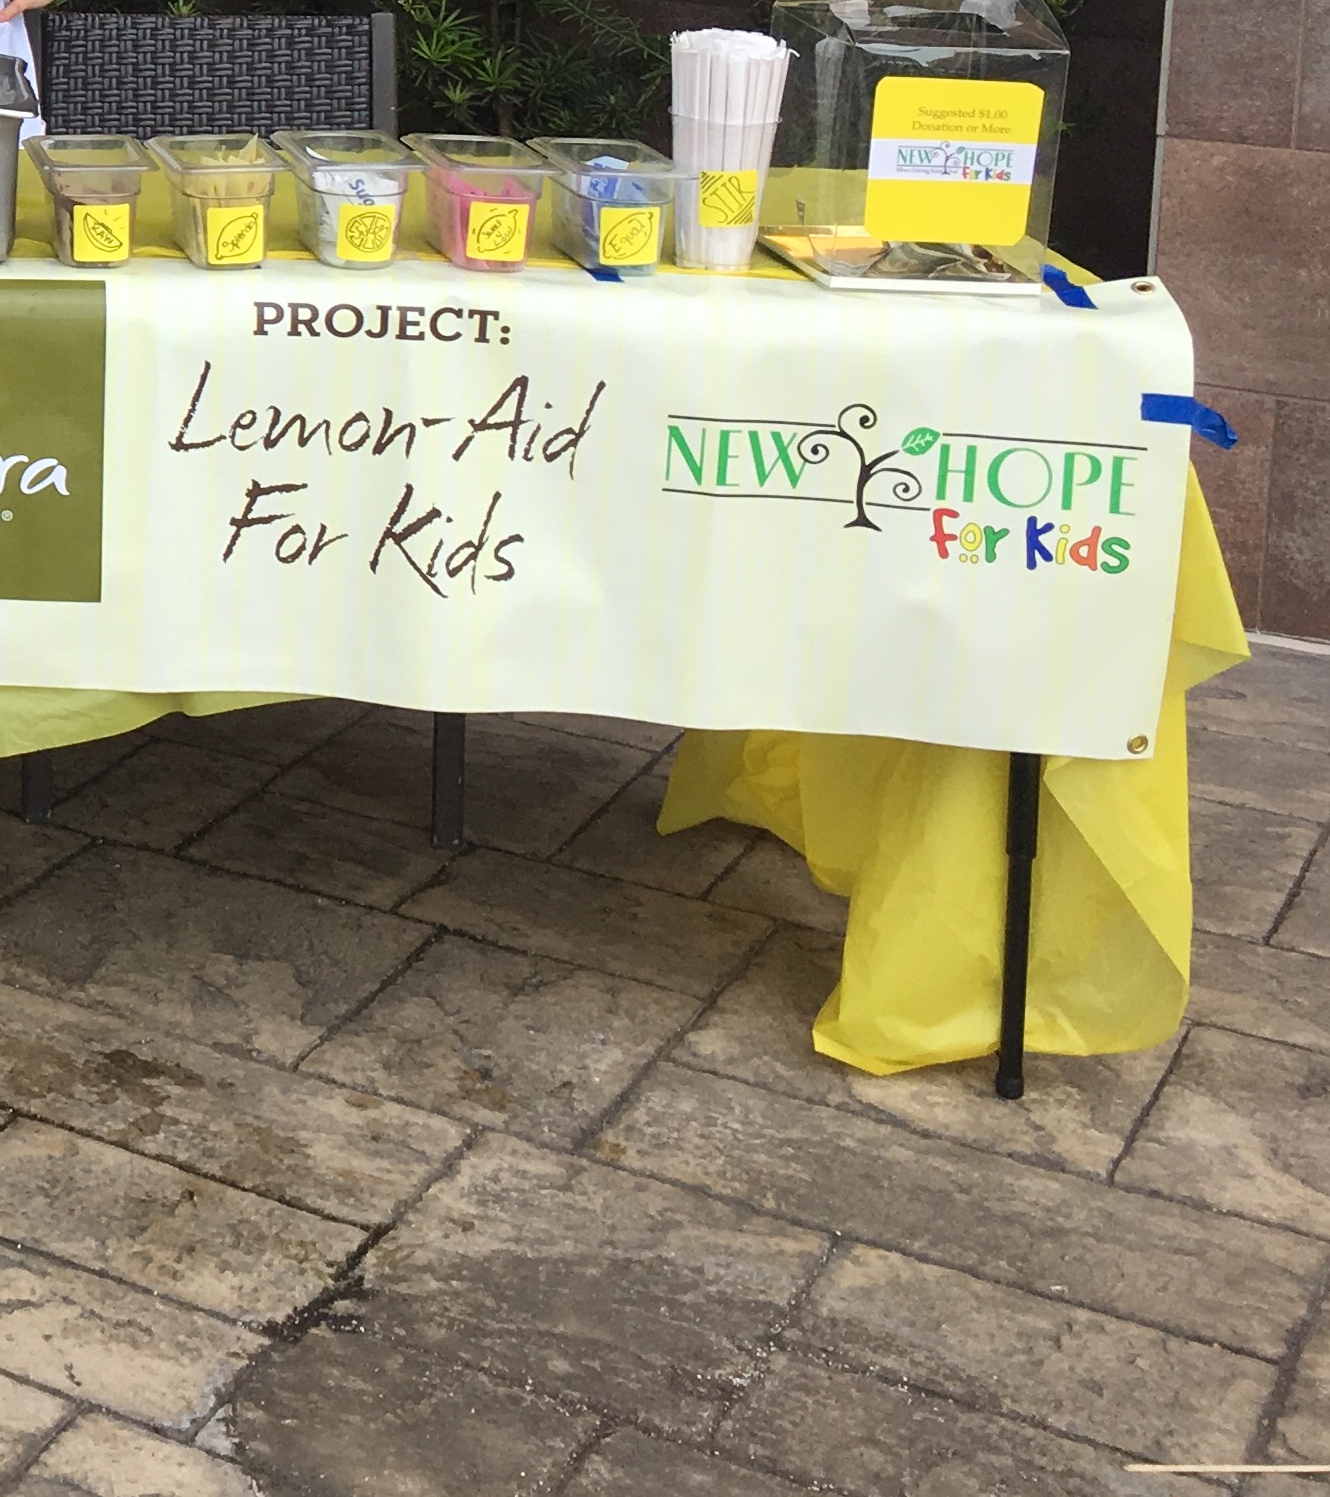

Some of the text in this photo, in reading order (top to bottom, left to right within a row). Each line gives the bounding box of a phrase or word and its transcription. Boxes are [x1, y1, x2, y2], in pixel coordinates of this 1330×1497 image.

[912, 120, 1012, 135] Donation or More
[918, 106, 1008, 120] Suggested $1.00
[897, 148, 1014, 168] NEW HOPE
[702, 175, 755, 224] STIR
[608, 217, 646, 253] Equal
[253, 301, 511, 345] PROJECT:
[168, 359, 606, 480] Lemon-Aid
[665, 424, 1138, 516] NEW HOPE
[222, 478, 525, 598] For Kids
